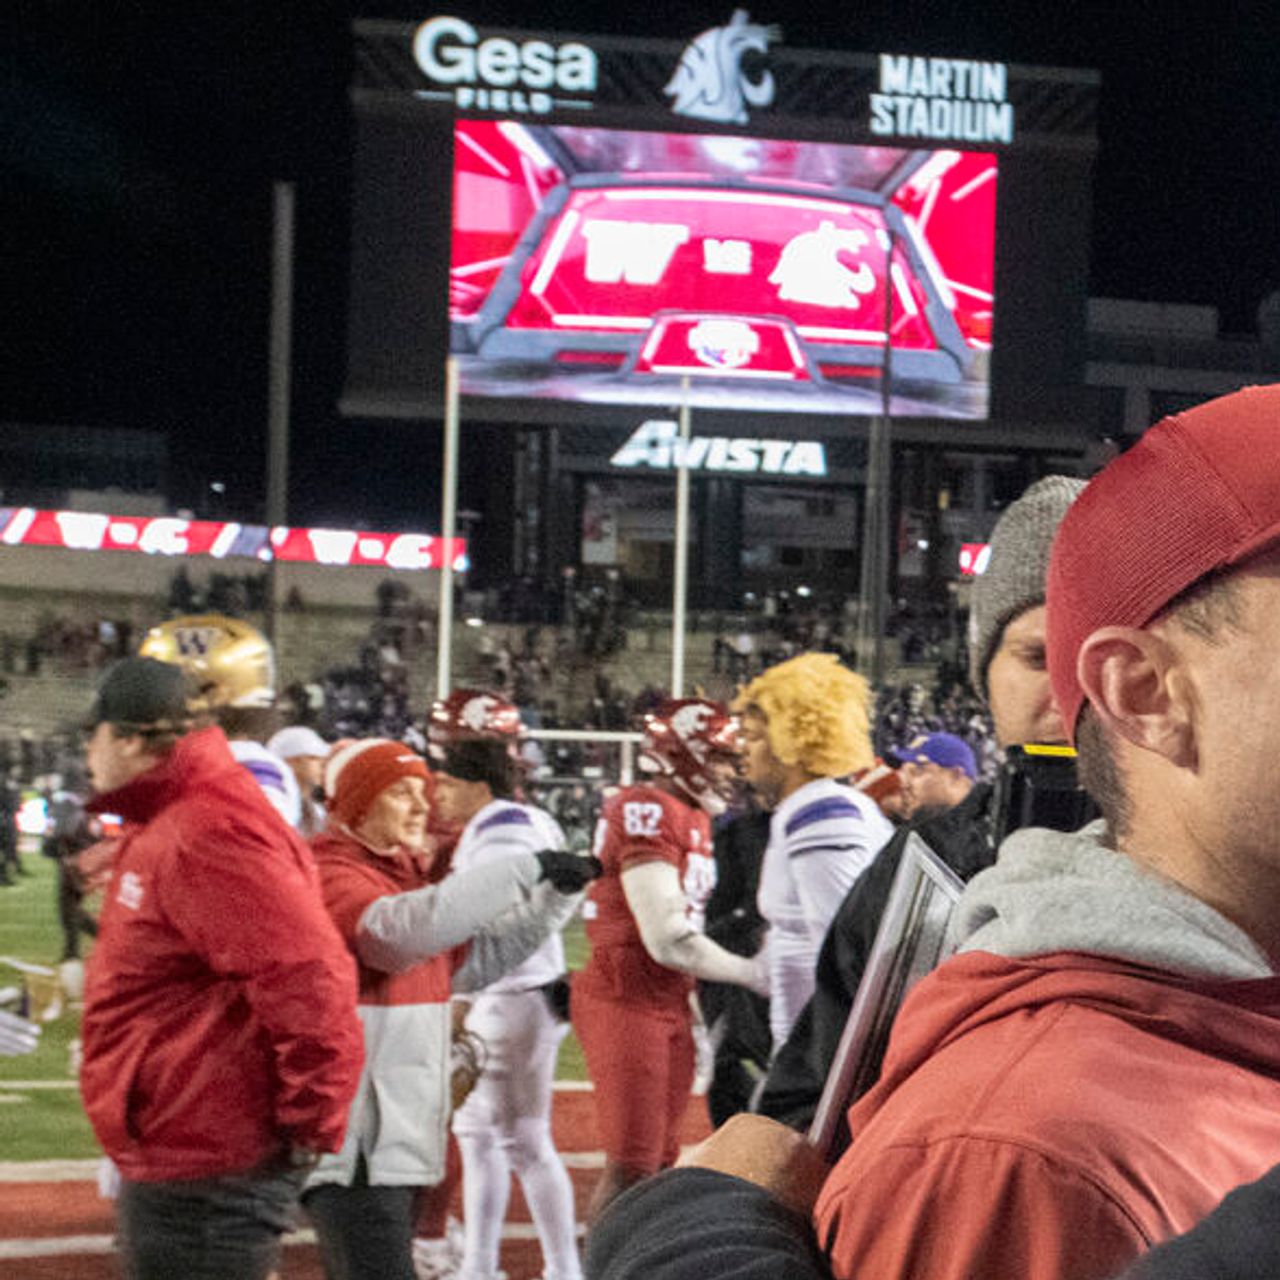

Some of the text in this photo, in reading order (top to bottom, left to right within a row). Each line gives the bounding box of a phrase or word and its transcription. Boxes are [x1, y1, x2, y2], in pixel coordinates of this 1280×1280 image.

[413, 15, 597, 91] Gesa
[879, 53, 1007, 103] MARTIN
[454, 87, 552, 114] FIELD
[869, 93, 1014, 144] STADIUM
[623, 802, 662, 836] 82
